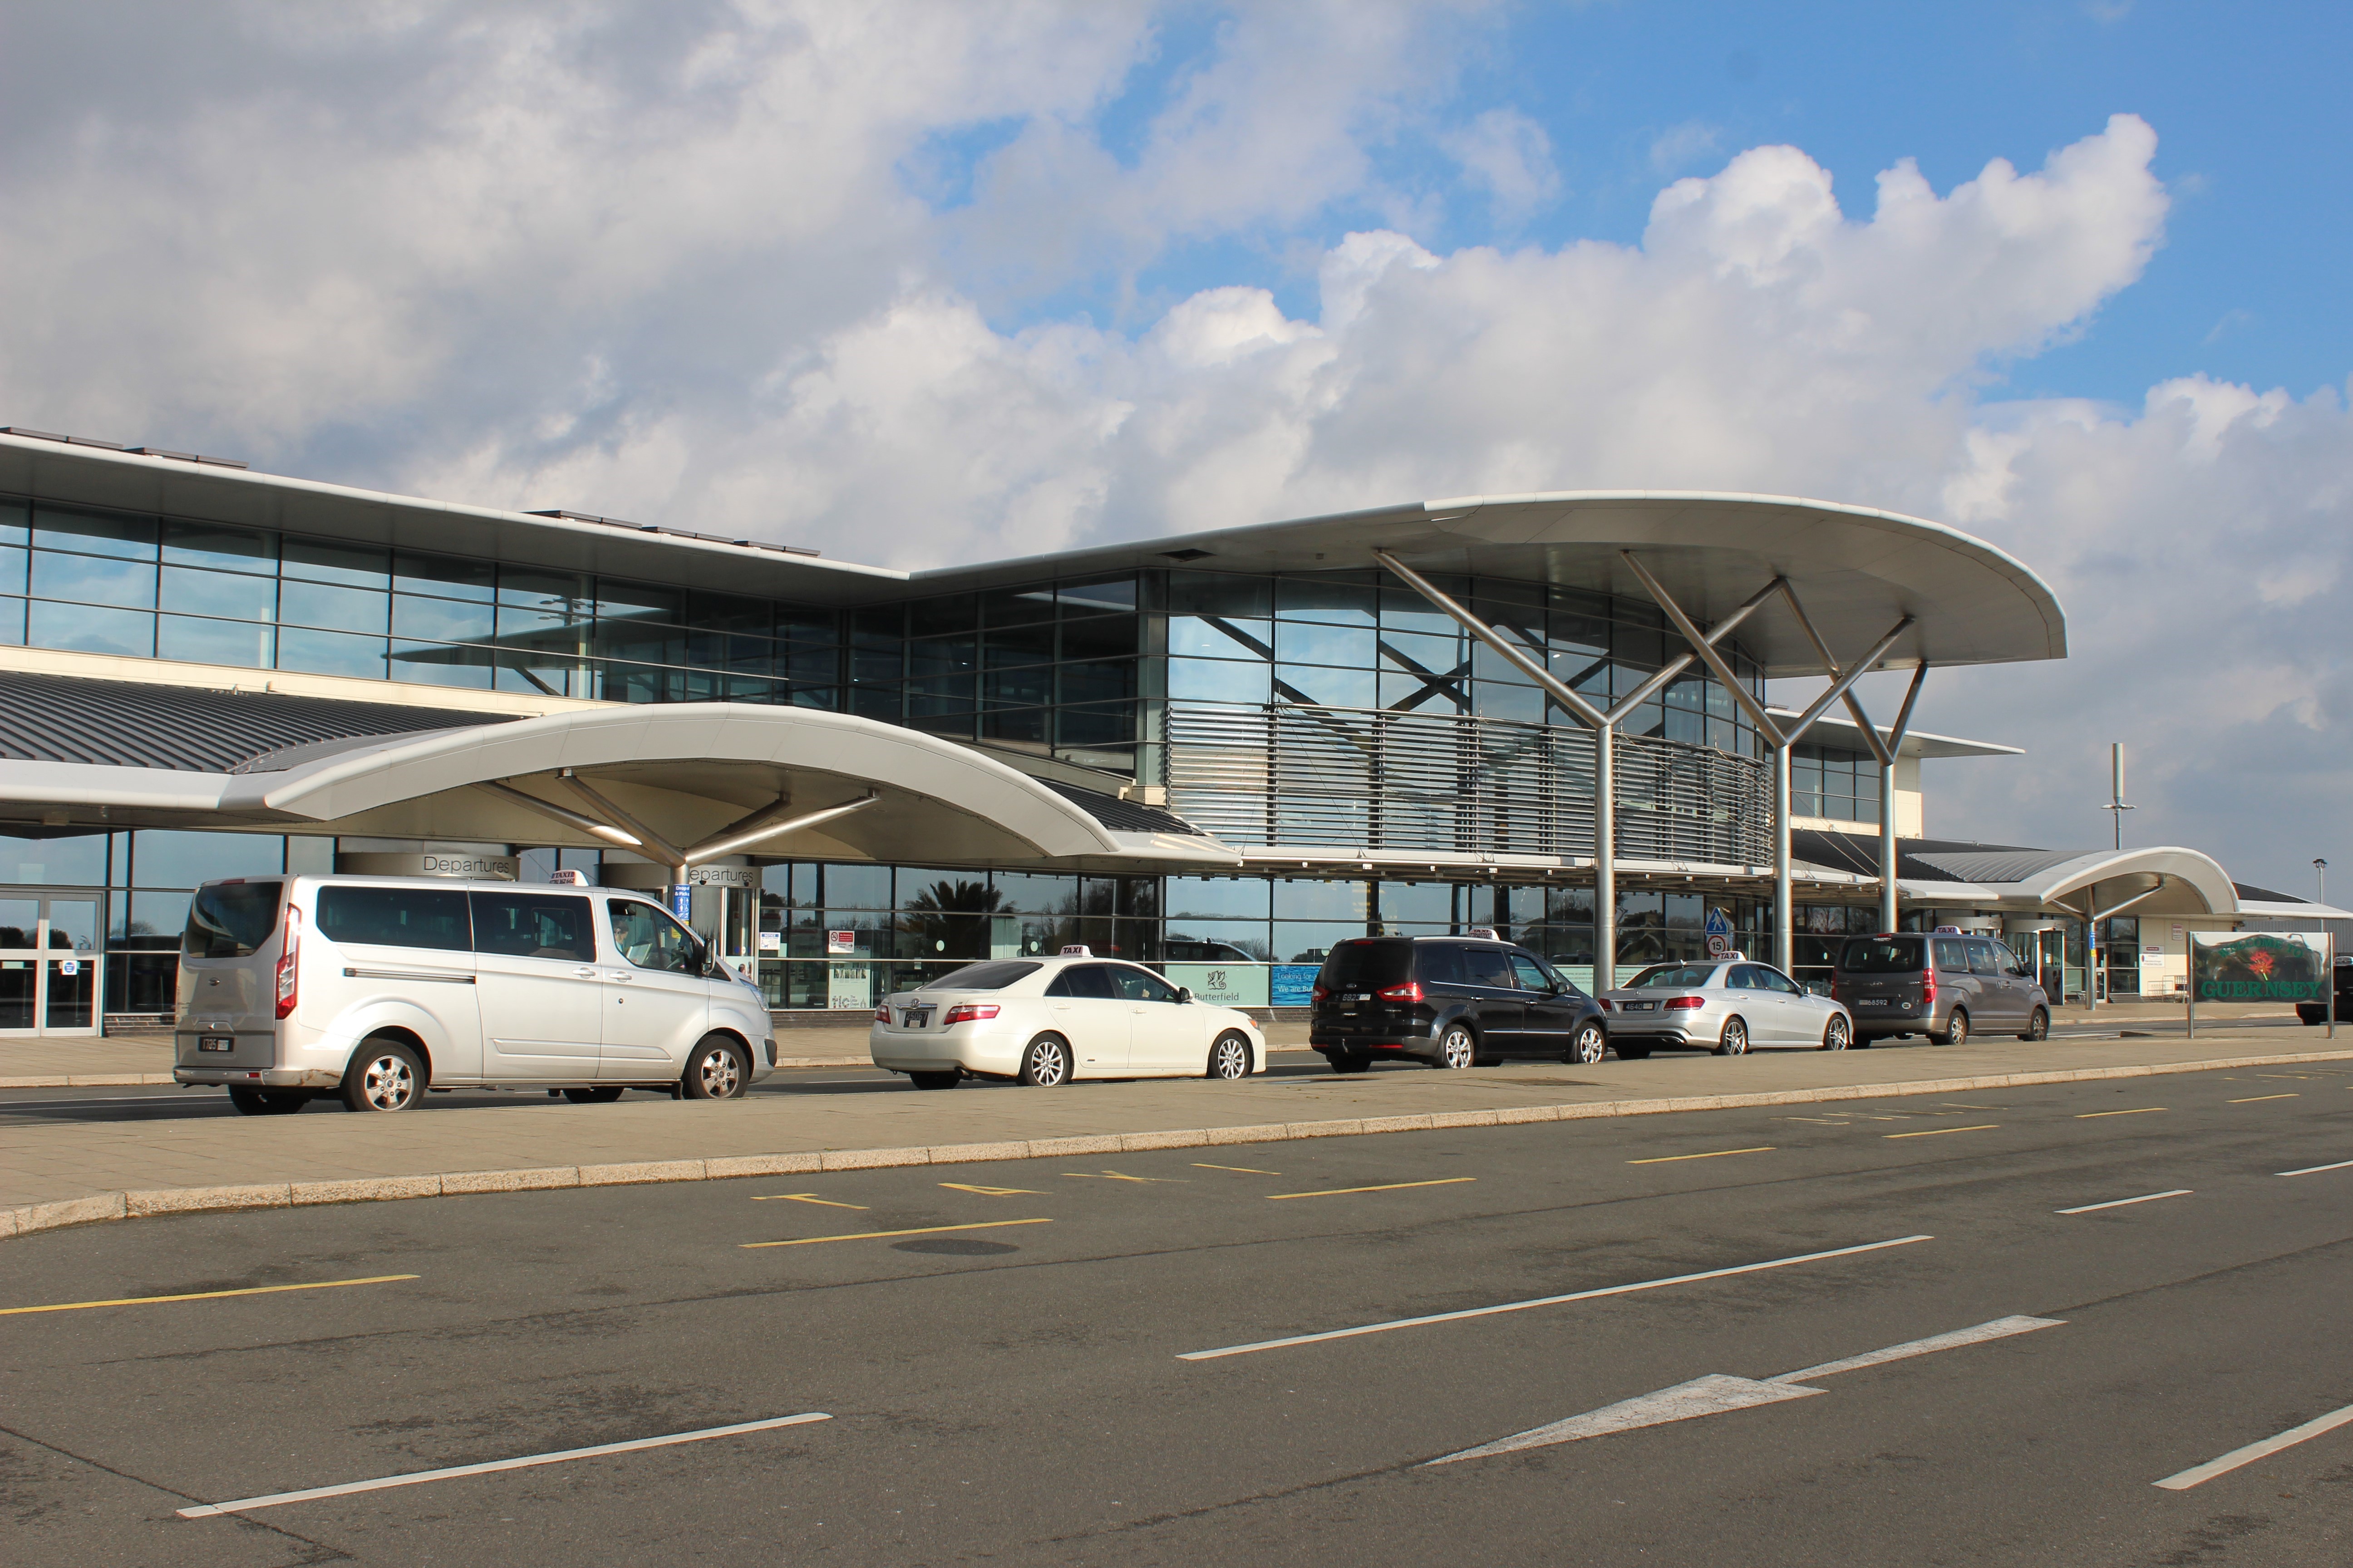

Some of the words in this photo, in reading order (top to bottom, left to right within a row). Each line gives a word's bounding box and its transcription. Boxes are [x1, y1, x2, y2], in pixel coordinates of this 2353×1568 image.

[424, 856, 509, 874] Departures
[690, 869, 753, 882] epartures
[1712, 942, 1721, 950] 15
[2218, 938, 2282, 958] WELCOME
[2287, 945, 2303, 958] TO
[1278, 973, 1301, 981] Looking
[2201, 981, 2322, 998] GUERNSEY
[1195, 993, 1239, 1001] Butterfield
[906, 1012, 928, 1021] 25067
